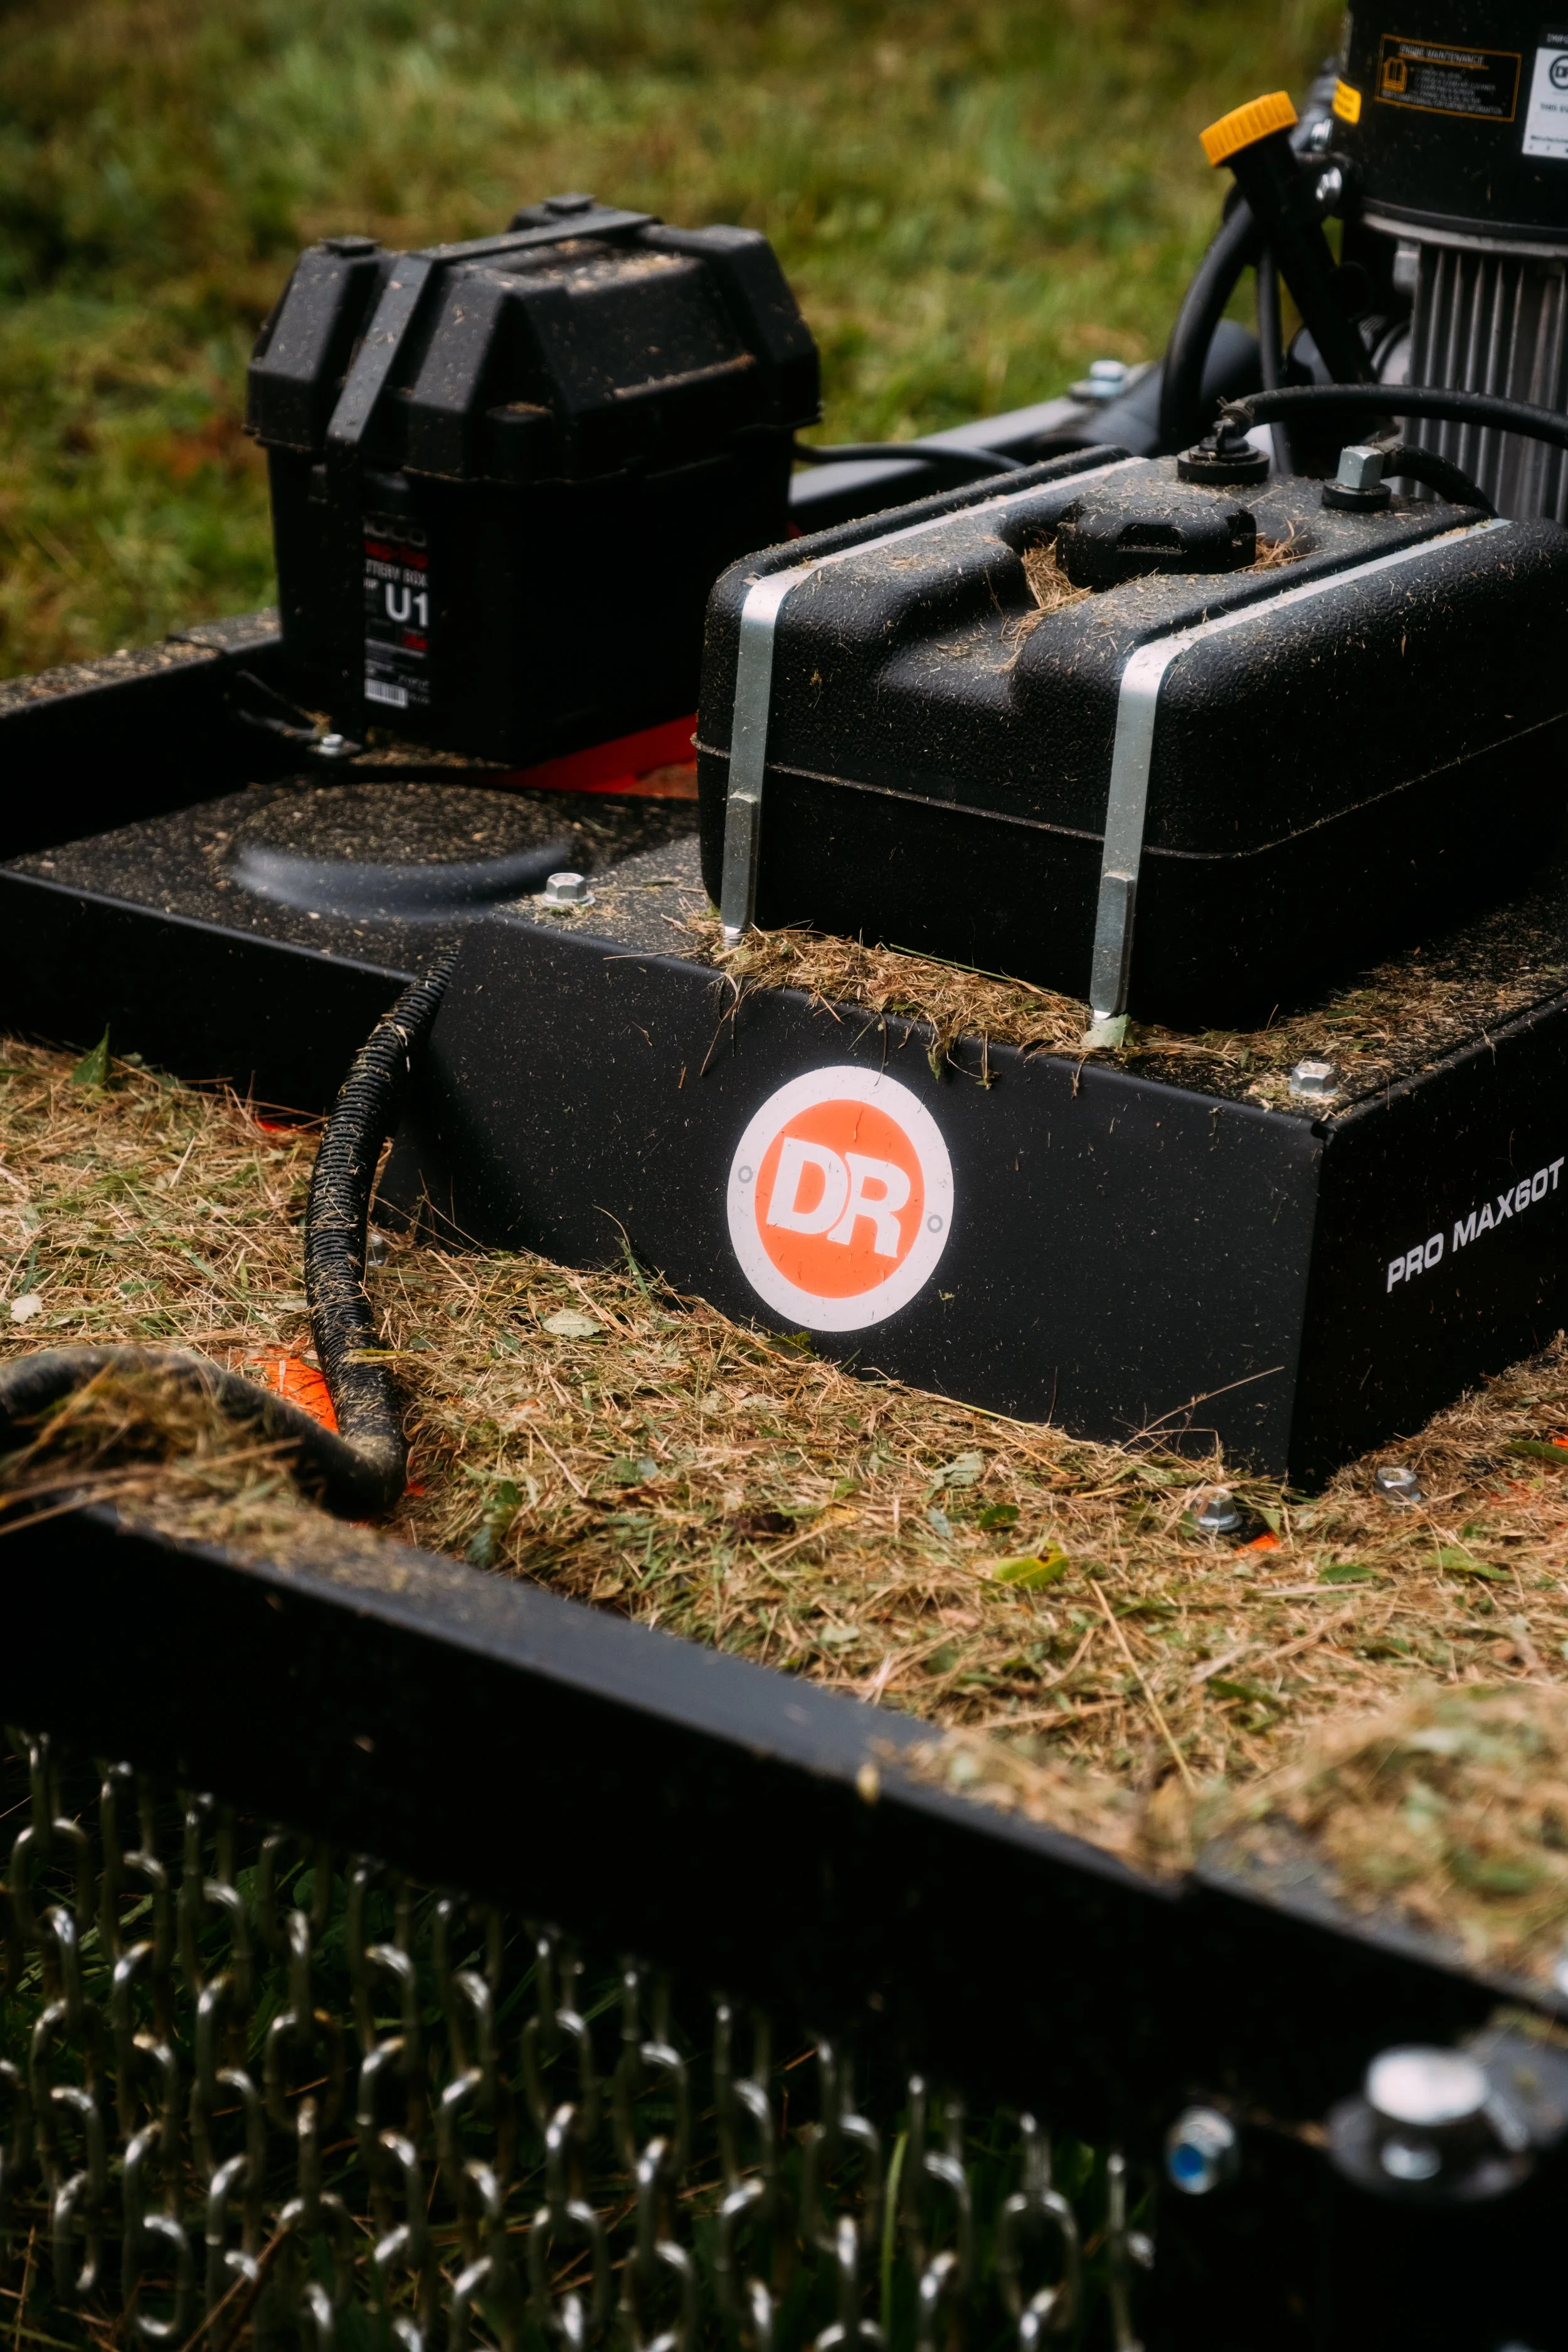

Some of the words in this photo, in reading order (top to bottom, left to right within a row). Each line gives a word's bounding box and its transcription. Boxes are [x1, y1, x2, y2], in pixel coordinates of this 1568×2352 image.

[1426, 49, 1485, 65] MAINTENANCE
[403, 568, 428, 588] BOX
[385, 581, 429, 628] U1
[766, 1136, 911, 1259] DR
[1387, 1232, 1444, 1293] PRO
[1451, 1156, 1565, 1253] MAX60T
